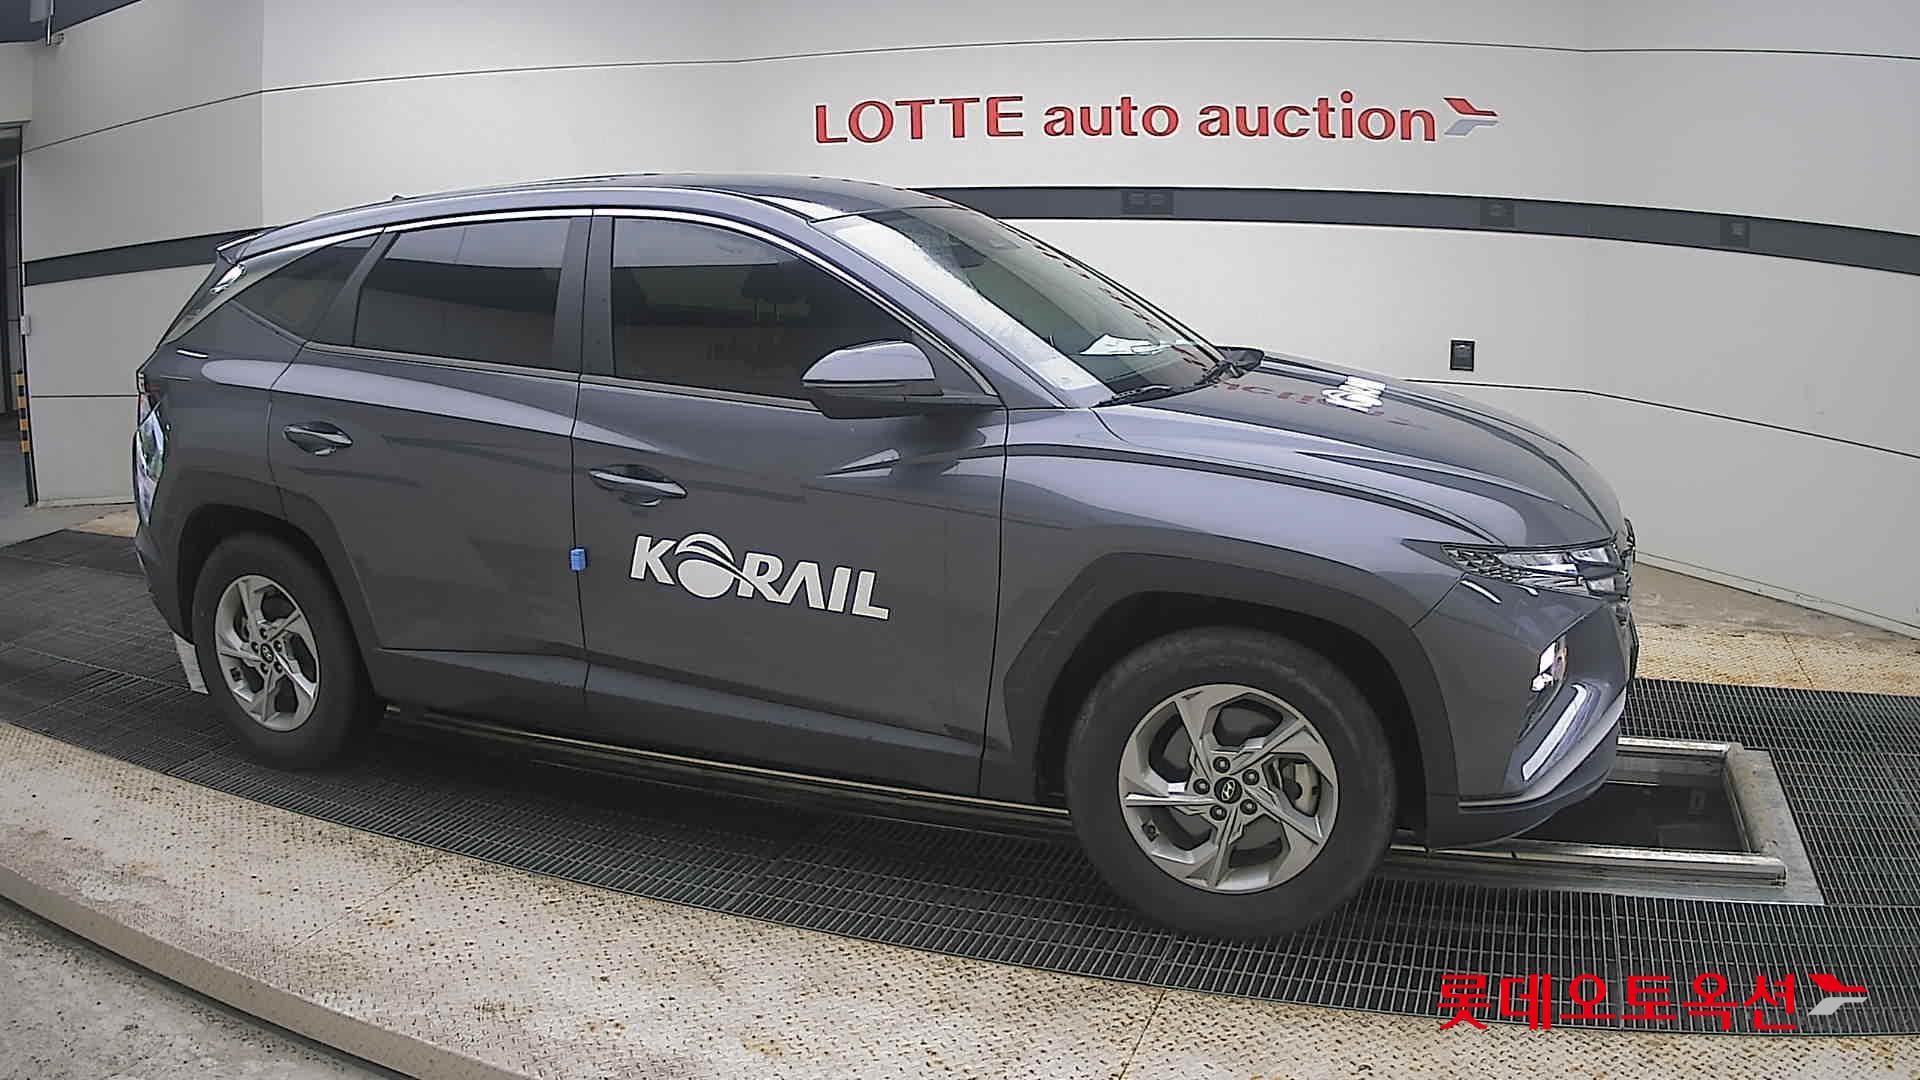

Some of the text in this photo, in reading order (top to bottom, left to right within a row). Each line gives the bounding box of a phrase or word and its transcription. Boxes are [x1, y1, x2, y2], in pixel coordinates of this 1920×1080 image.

[815, 91, 1437, 143] LOTTE auto auction
[629, 532, 890, 621] KORAIL
